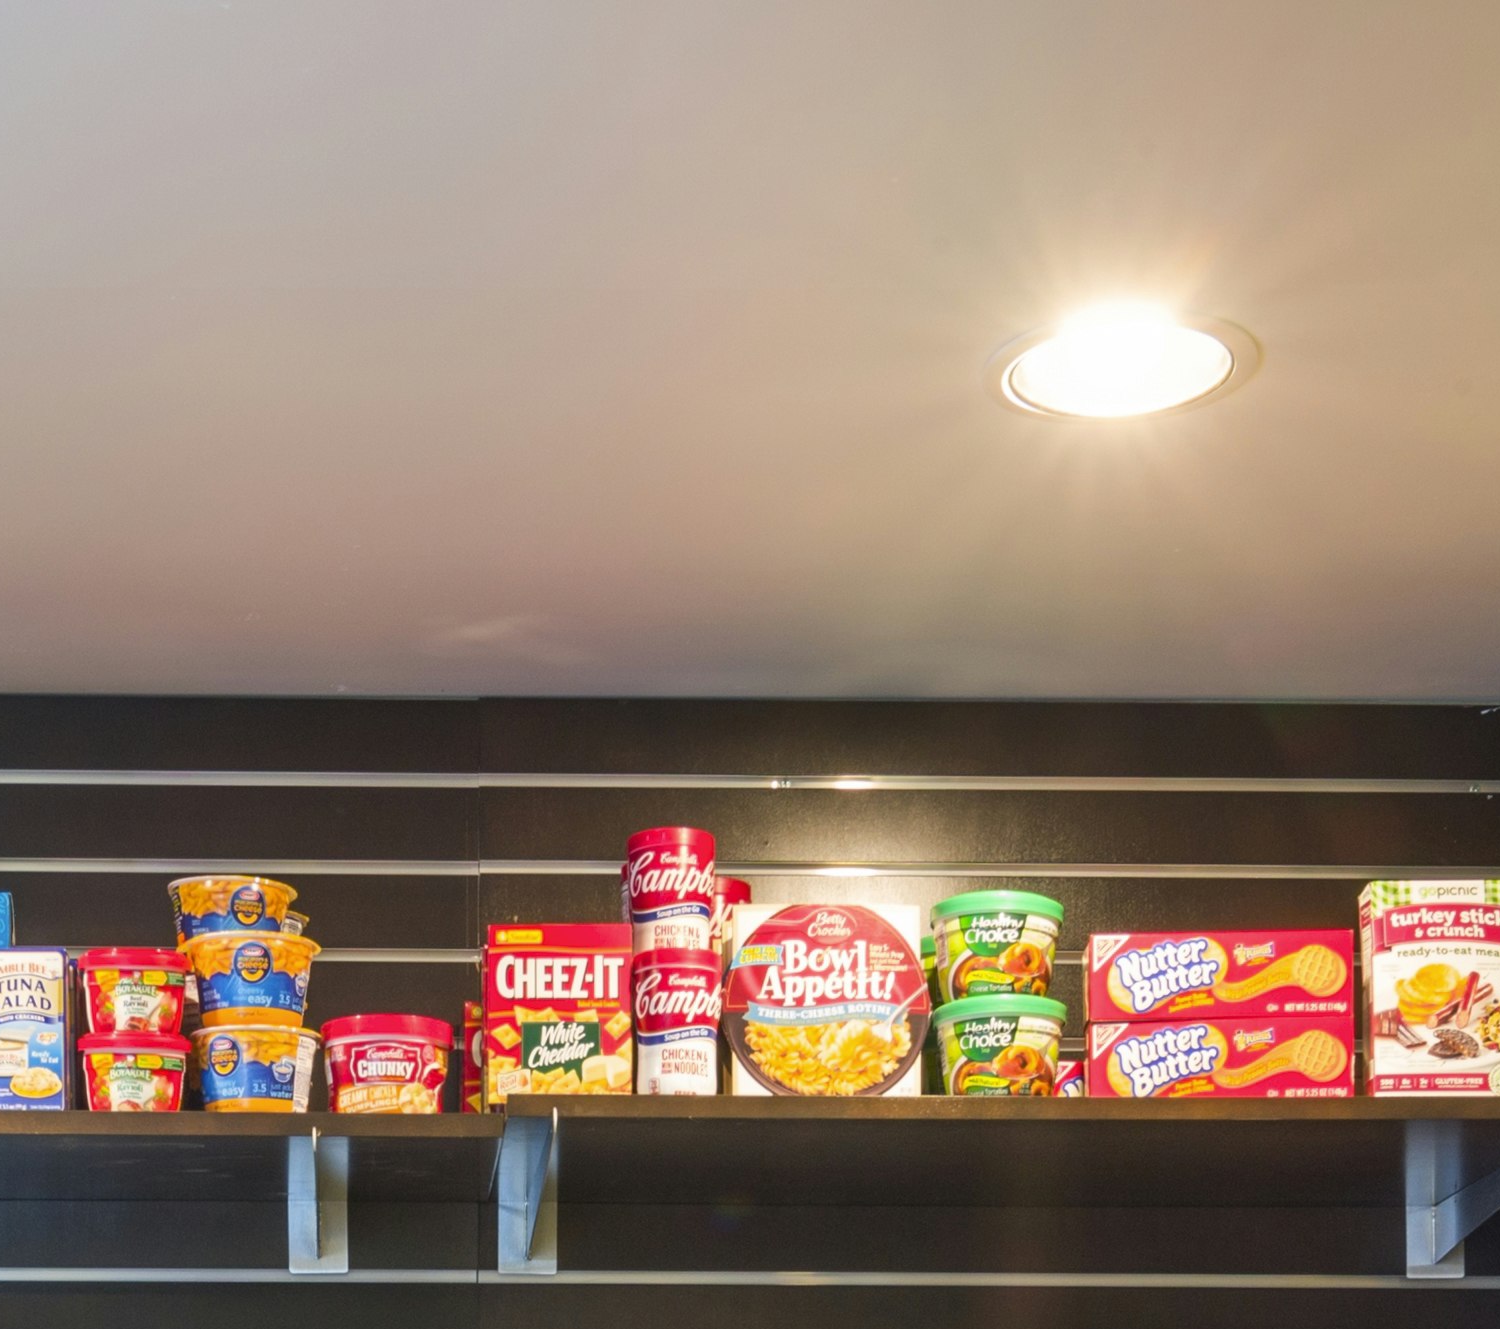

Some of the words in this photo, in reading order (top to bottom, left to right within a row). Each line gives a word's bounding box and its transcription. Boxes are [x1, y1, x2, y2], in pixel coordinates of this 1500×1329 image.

[816, 912, 847, 927] Betty
[971, 912, 1023, 930] Healthy
[1390, 910, 1455, 929] turkey
[807, 923, 852, 938] Crocker
[964, 927, 1020, 944] Choice
[1414, 926, 1422, 938] &
[1425, 924, 1485, 939] crunch
[781, 940, 868, 974] Bowl
[1397, 947, 1472, 959] ready-to-eat
[1116, 939, 1207, 987] Nutter
[496, 955, 625, 999] CHEEZ-IT
[1131, 960, 1218, 1012] Butter
[248, 994, 272, 1007] easy
[279, 993, 291, 1004] 3.5
[757, 1004, 845, 1018] THREE-CHEESE
[847, 1003, 892, 1017] ROTINI
[540, 1021, 586, 1046] White
[964, 1017, 1015, 1033] Healthy
[959, 1029, 1013, 1047] Choice
[527, 1040, 595, 1069] Cheddar
[661, 1048, 702, 1061] CHICKEN
[1116, 1025, 1207, 1074] Nutter
[357, 1059, 414, 1080] CHUNKY
[1131, 1046, 1218, 1097] Butter
[222, 1085, 244, 1098] easy
[252, 1082, 267, 1093] 3.5
[339, 1087, 368, 1108] CREAMY
